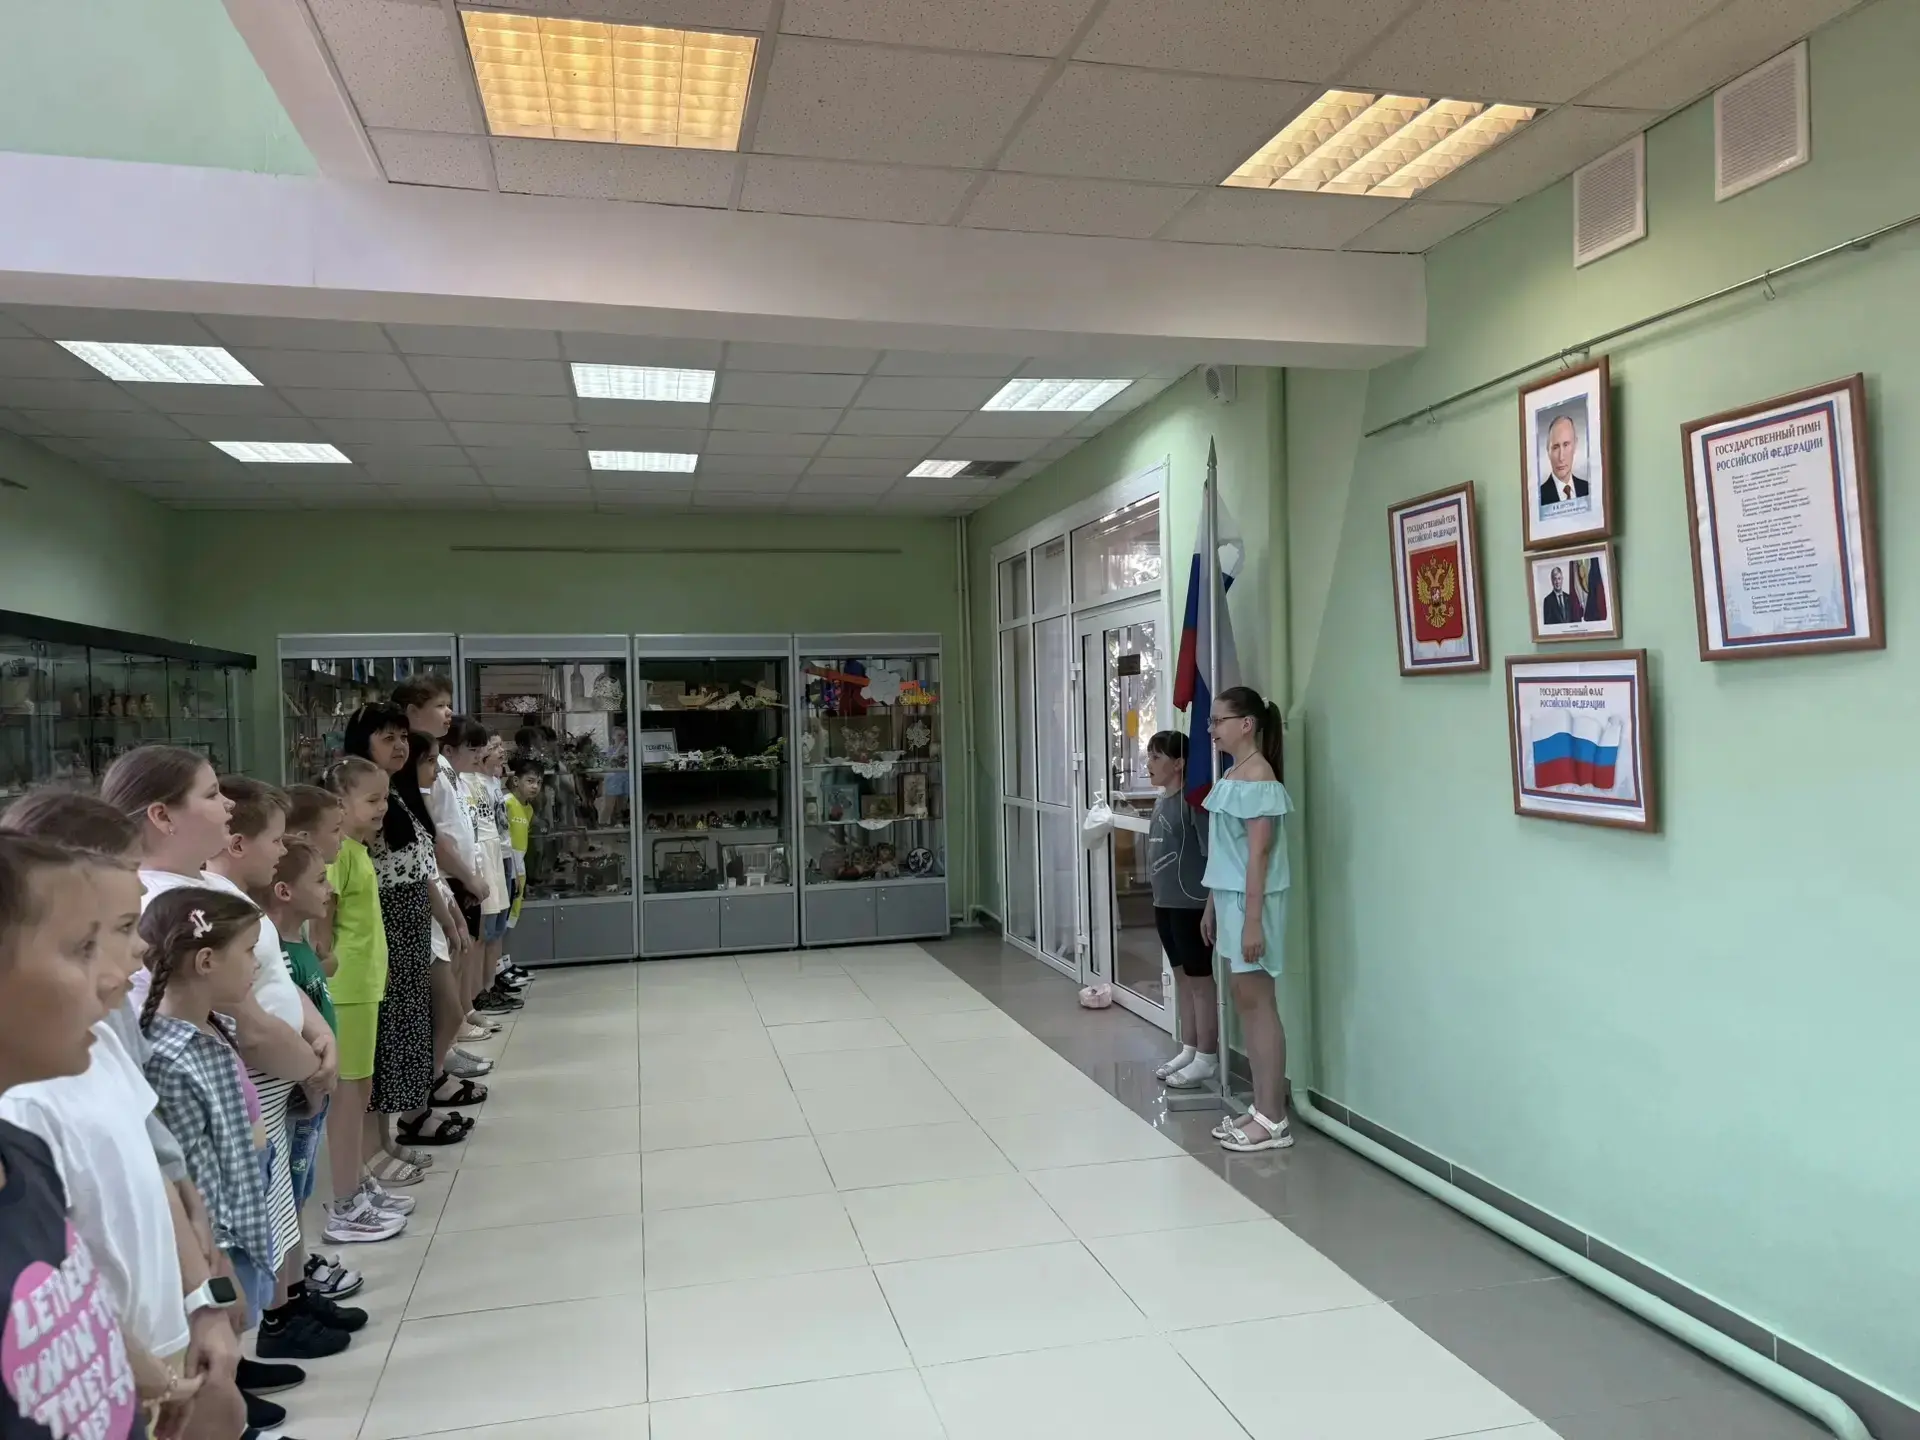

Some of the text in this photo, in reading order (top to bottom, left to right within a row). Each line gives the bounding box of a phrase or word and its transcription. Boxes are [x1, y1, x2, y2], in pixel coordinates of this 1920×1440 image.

[1715, 420, 1821, 456] ГОСУДАРСТВЕННЫЙ ГИМН
[1716, 437, 1823, 471] РОССИЙСКОЙ ФЕДЕРАЦИИ
[1540, 685, 1588, 697] ГОСУДАРСТВЕННЫЙ
[1540, 697, 1606, 710] РОССИЙСКОЙ ФЕДЕРАЦИИ
